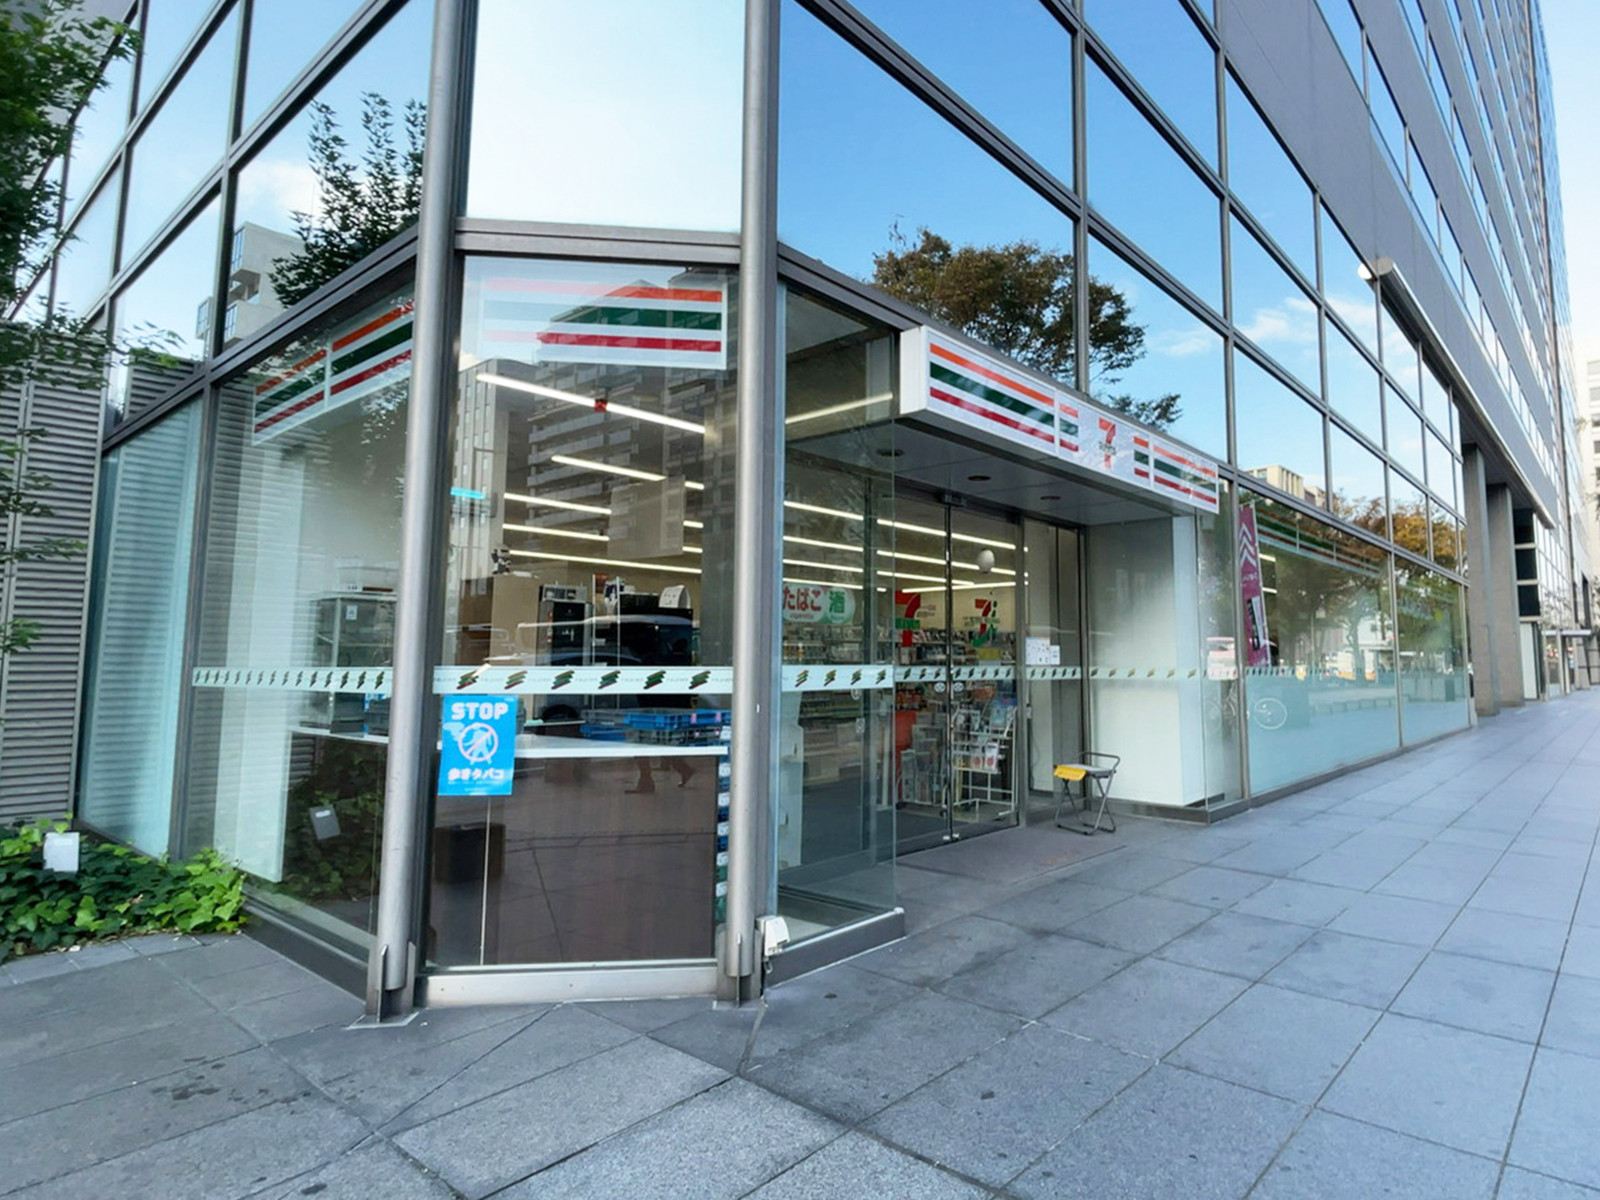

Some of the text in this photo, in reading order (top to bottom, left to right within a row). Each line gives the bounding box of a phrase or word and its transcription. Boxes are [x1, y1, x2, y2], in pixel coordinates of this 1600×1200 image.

[783, 586, 821, 611] たばこ
[451, 702, 508, 720] STOP
